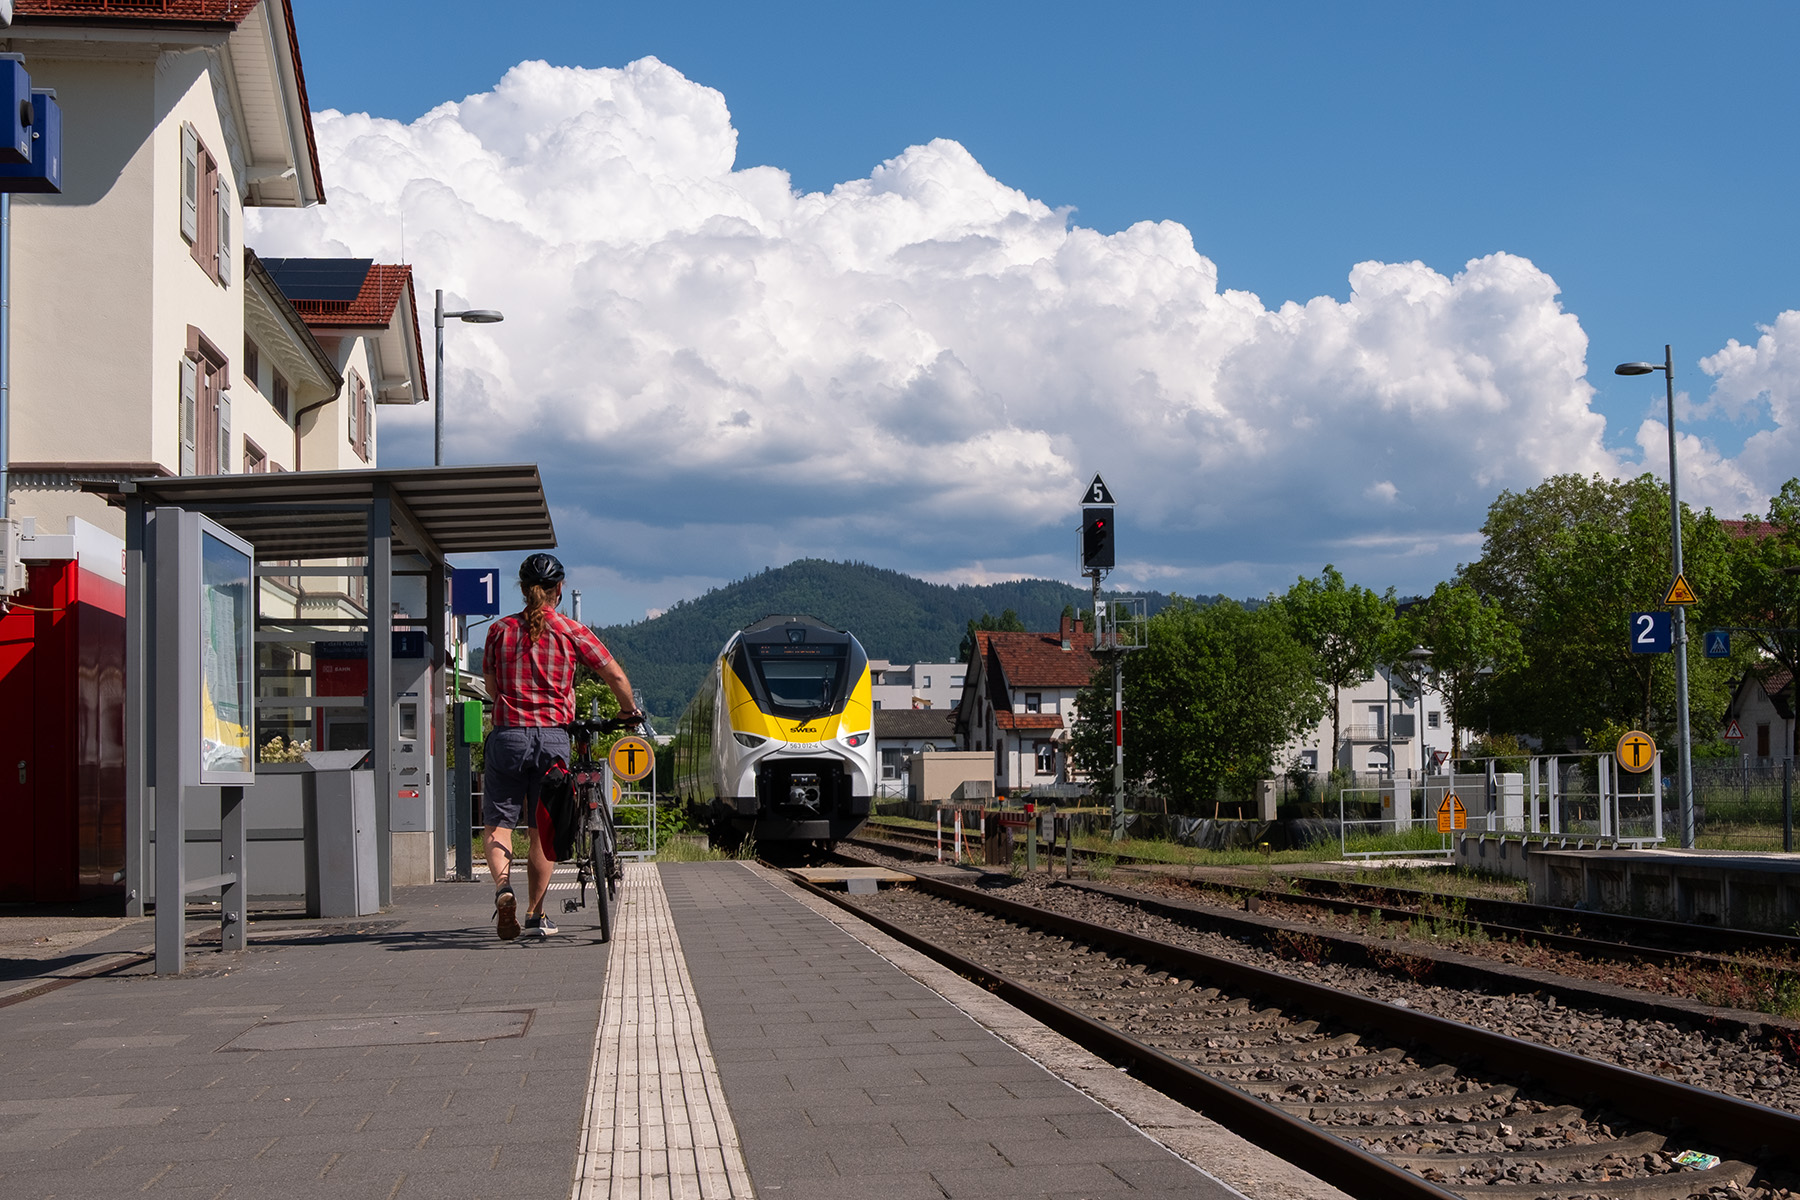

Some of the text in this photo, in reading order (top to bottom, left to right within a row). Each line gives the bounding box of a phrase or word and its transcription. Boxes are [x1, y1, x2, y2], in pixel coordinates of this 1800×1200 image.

[1093, 483, 1103, 502] 5
[479, 573, 493, 604] 1
[1636, 614, 1655, 644] 2
